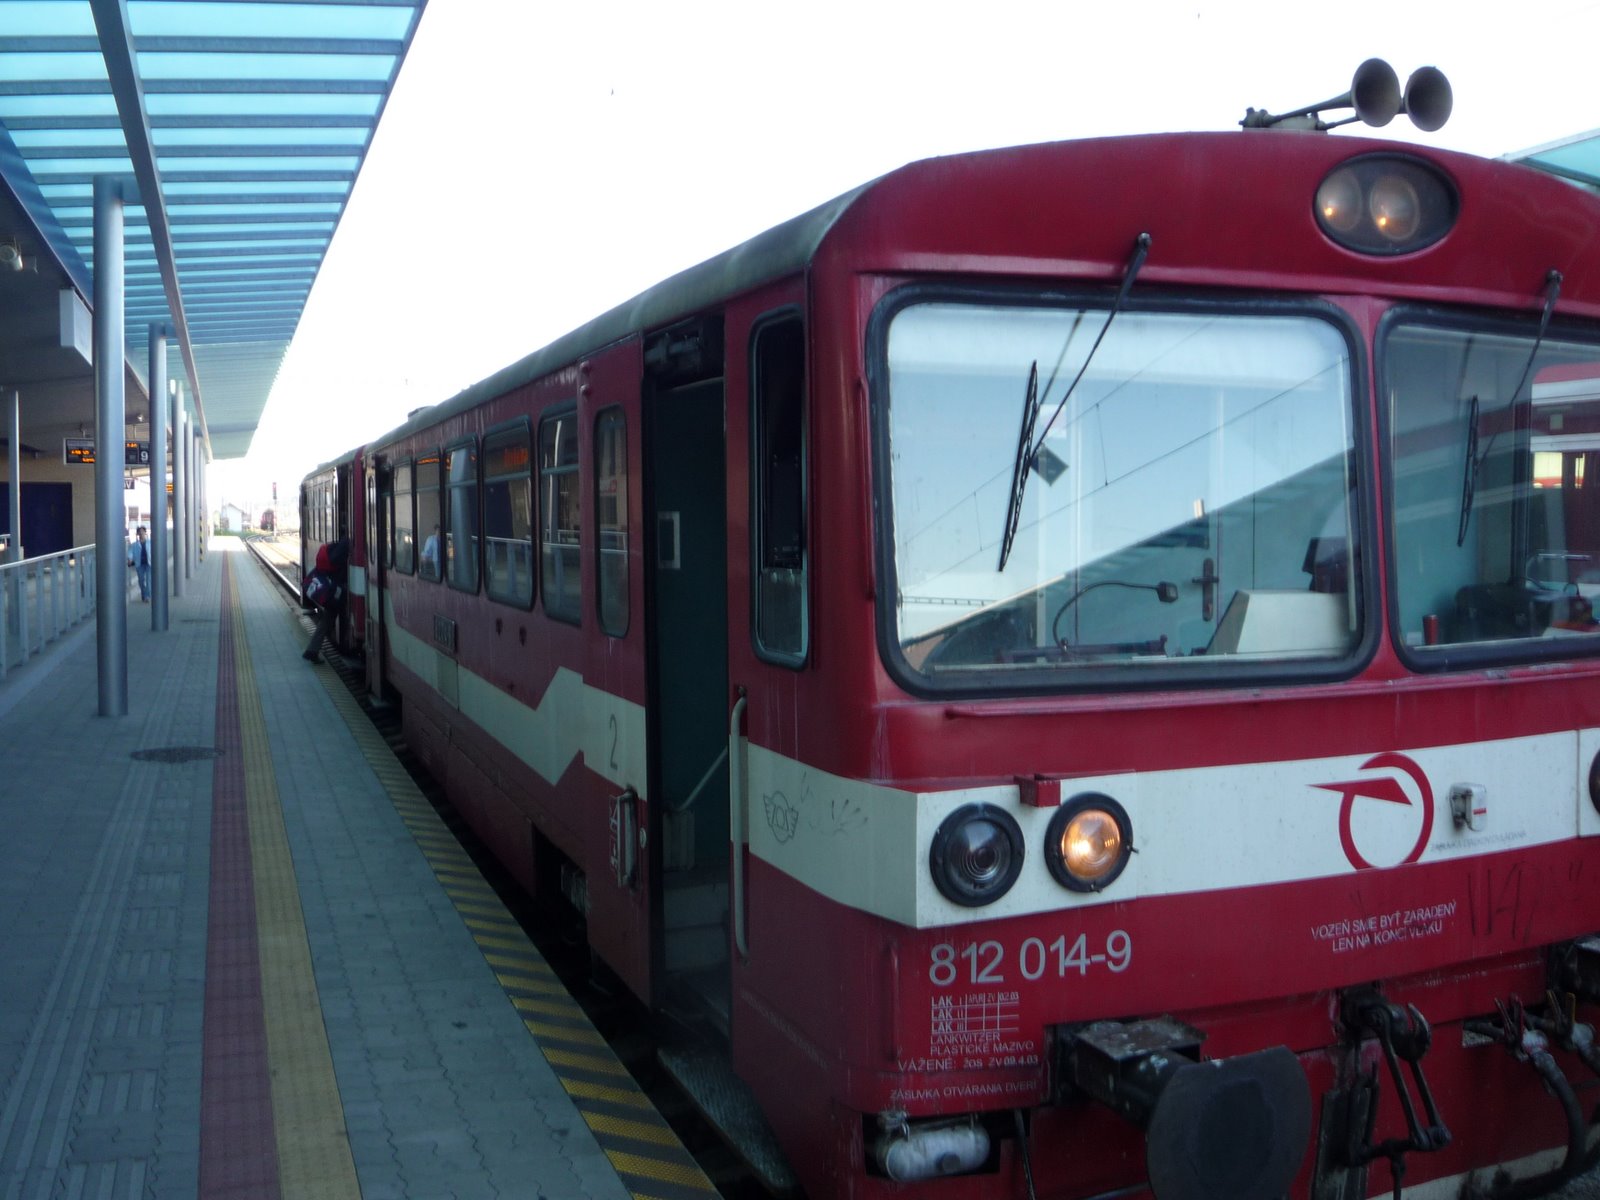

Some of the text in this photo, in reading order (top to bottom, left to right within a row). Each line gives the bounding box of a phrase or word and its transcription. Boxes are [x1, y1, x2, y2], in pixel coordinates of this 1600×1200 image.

[140, 450, 149, 462] 9
[609, 713, 618, 771] 2
[1310, 919, 1350, 940] VOZEŇ
[1379, 910, 1401, 929] BYŤ
[1403, 900, 1457, 924] ZARADENÝ
[1332, 935, 1354, 953] LEN
[1356, 932, 1370, 949] NA
[929, 930, 1132, 986] 812 014-9
[931, 995, 953, 1008] LAK
[931, 1008, 953, 1021] LAK
[931, 1021, 953, 1034] LAK
[930, 1031, 1000, 1045] LANKWITZER
[993, 1040, 1034, 1054] MAZIVO
